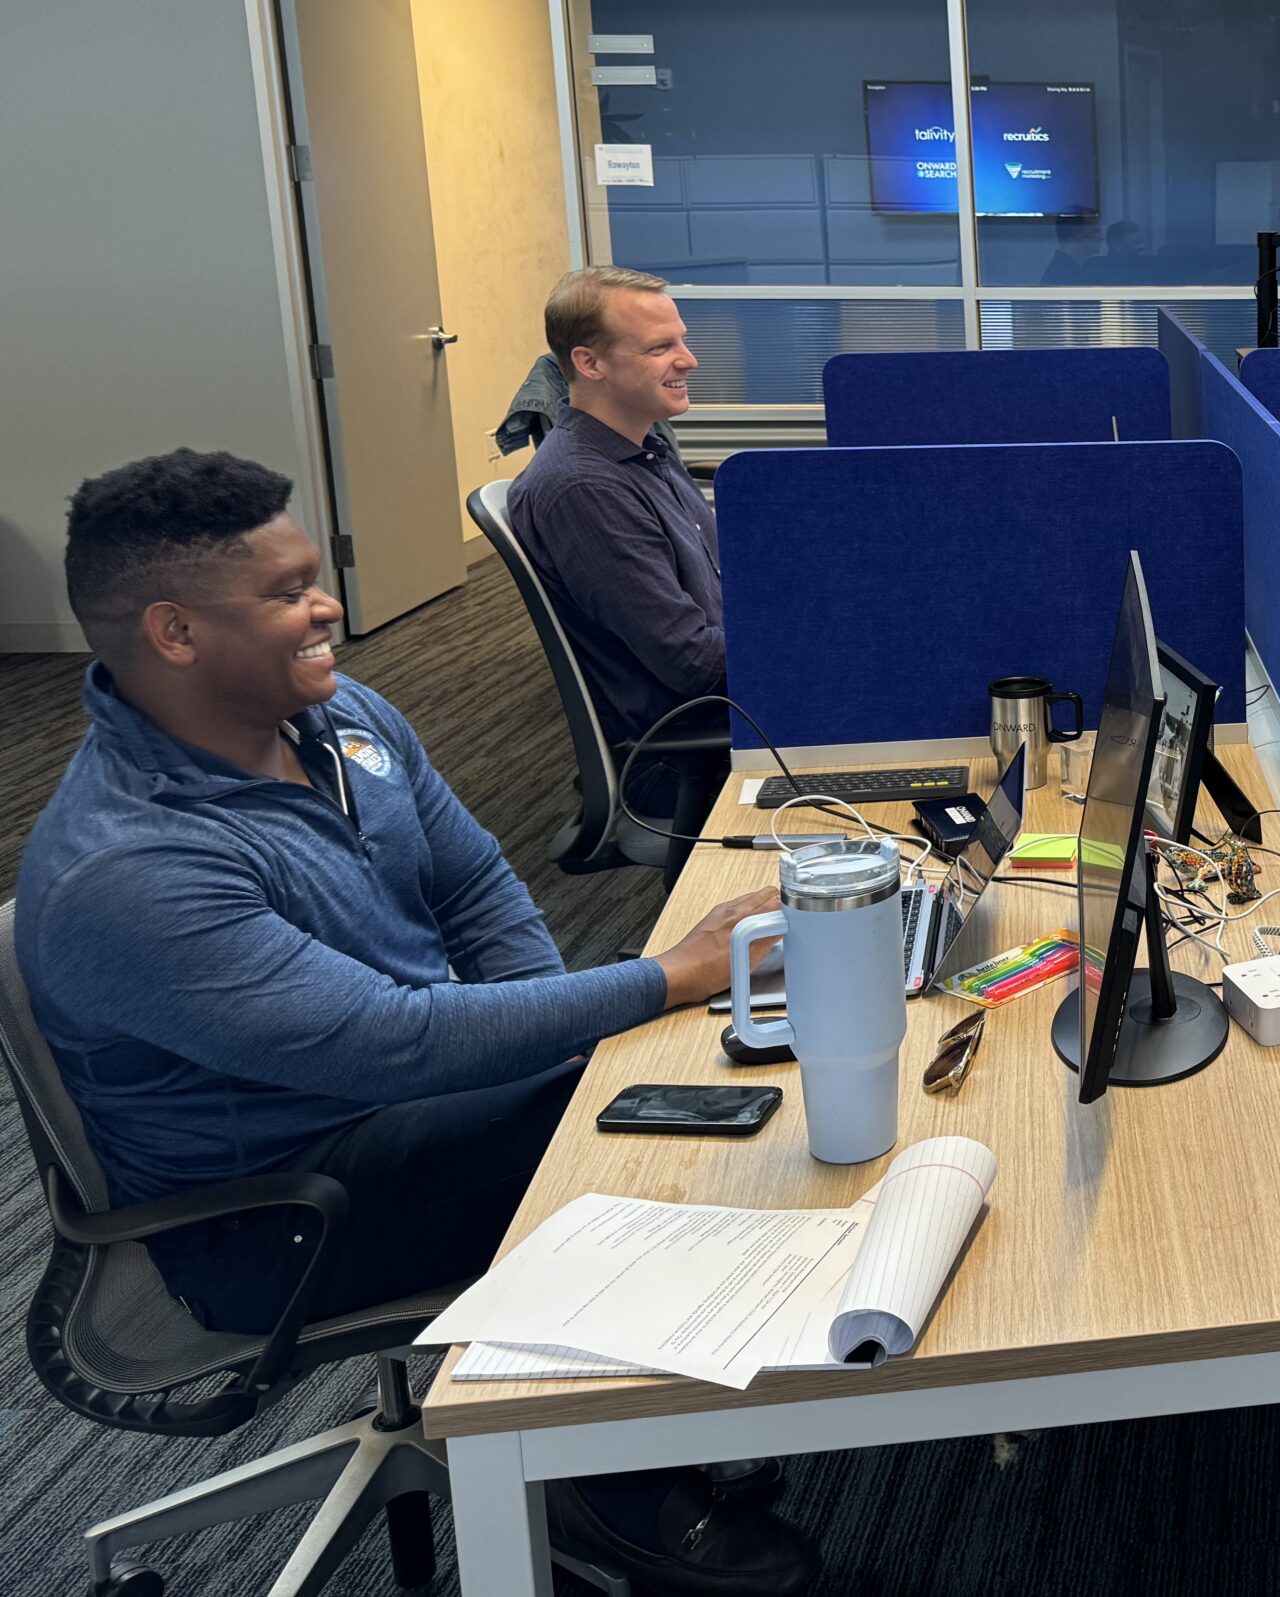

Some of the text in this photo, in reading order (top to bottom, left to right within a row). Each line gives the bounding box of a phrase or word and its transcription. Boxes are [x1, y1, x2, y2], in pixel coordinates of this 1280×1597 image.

[914, 126, 955, 143] talivity
[1003, 126, 1049, 142] recruitics
[916, 162, 957, 170] ONWARD
[924, 170, 957, 178] SEARCH
[992, 721, 1036, 733] ONWARD
